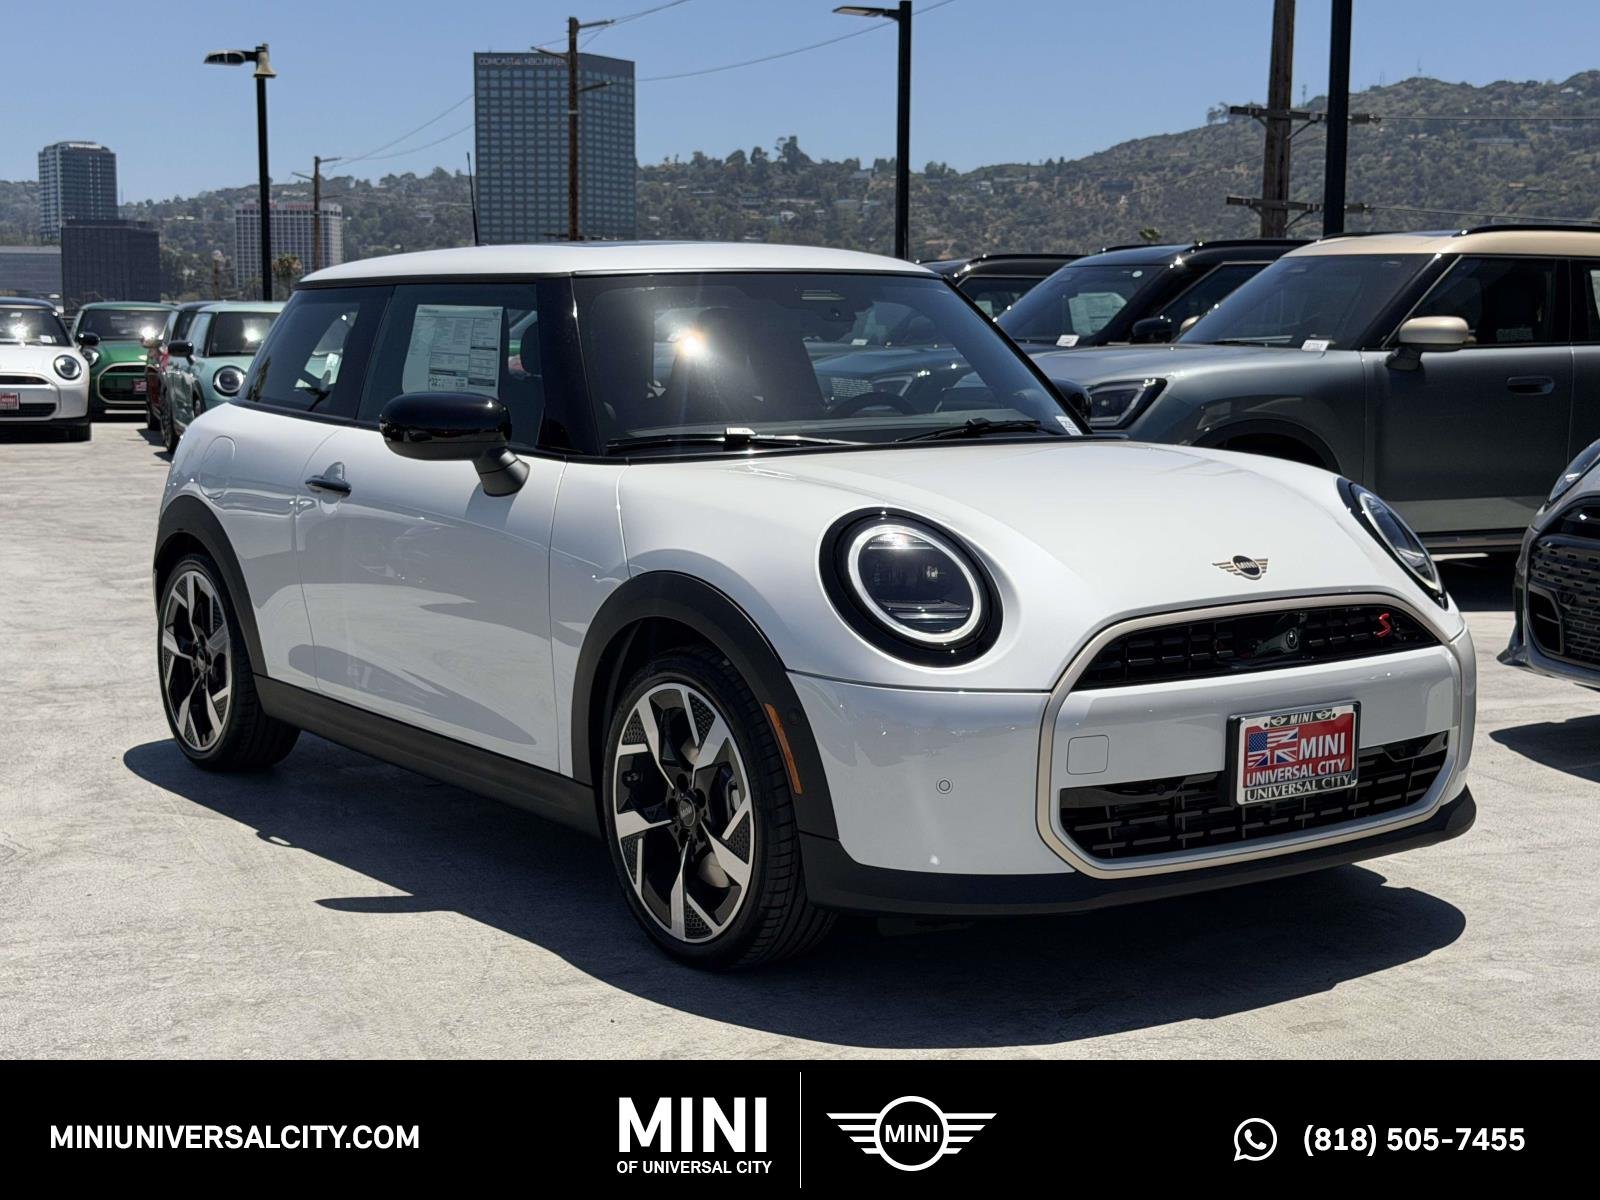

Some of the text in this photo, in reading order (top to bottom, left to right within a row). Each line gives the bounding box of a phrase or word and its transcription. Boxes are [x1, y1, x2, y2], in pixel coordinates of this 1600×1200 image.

[1235, 561, 1257, 570] MINI
[1375, 612, 1392, 638] S
[1289, 712, 1314, 725] MINI
[1299, 732, 1346, 760] MINI
[1246, 758, 1346, 787] UNIVERSAL CITY
[1246, 774, 1351, 801] UNIVERSAL CITY
